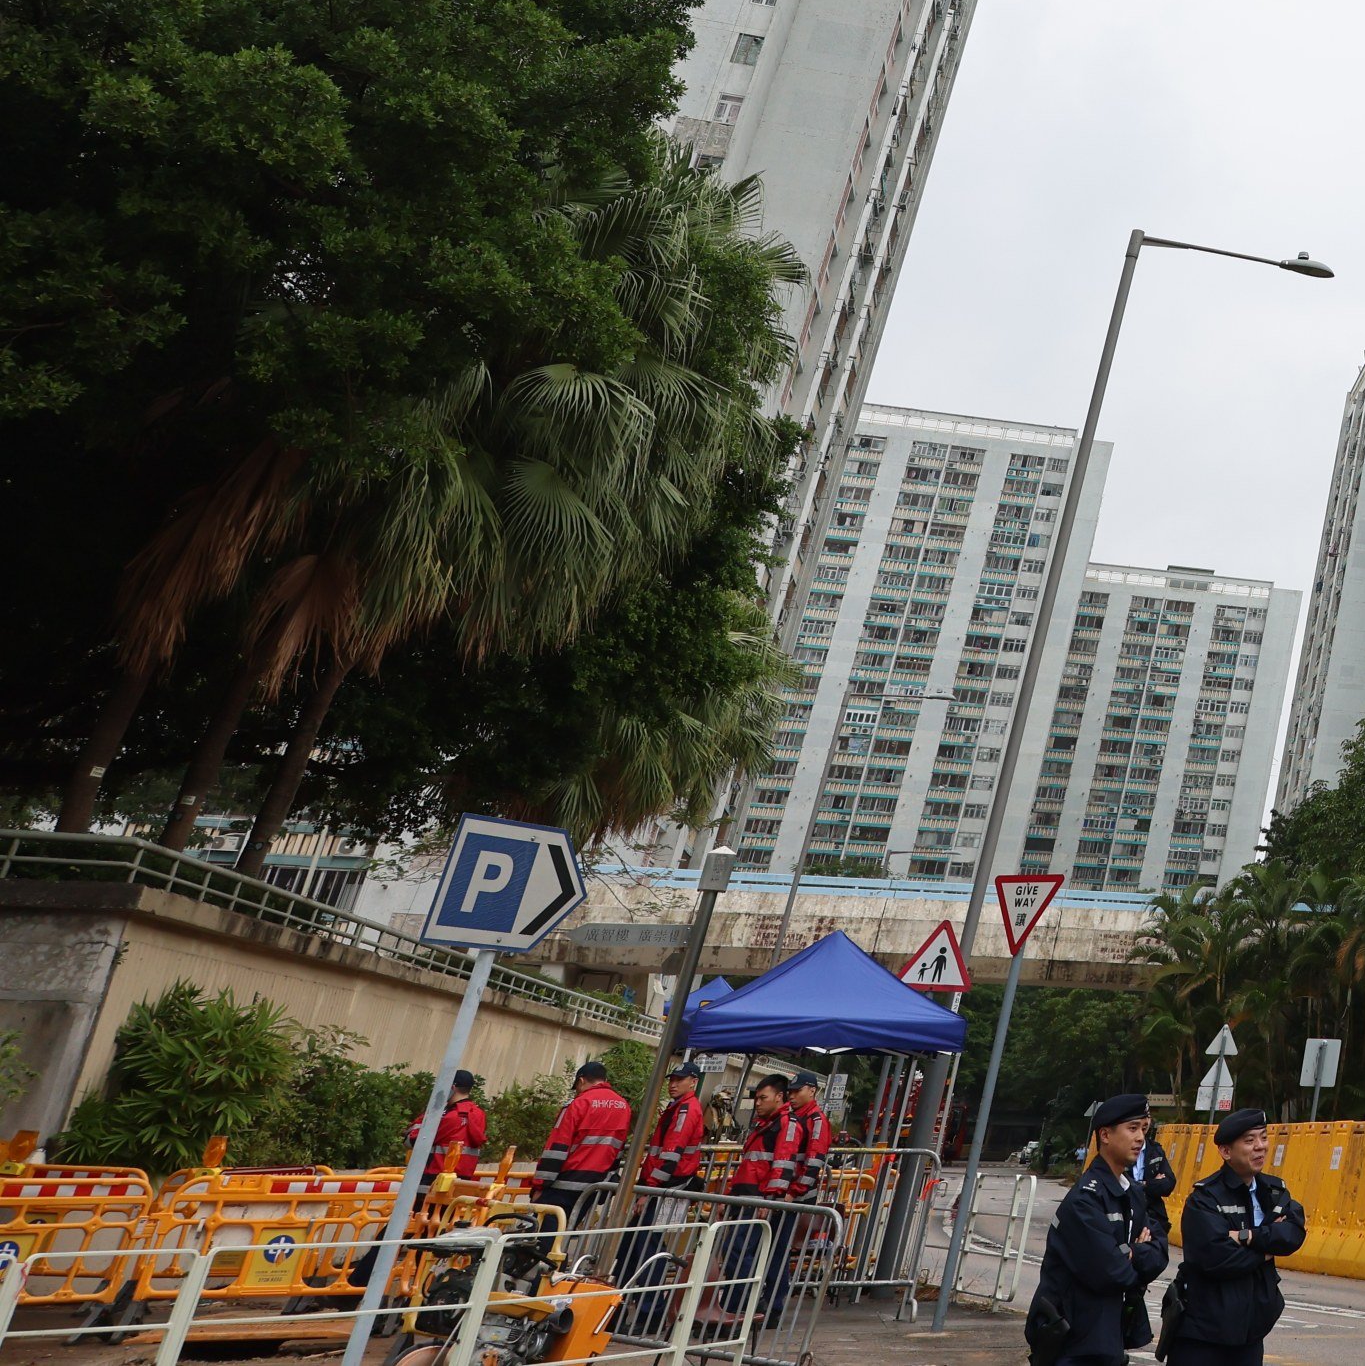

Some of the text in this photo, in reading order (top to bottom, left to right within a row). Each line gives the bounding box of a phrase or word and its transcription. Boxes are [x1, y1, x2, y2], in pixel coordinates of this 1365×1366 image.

[460, 850, 514, 913] P
[1016, 886, 1039, 895] GIVE
[1014, 898, 1036, 907] WAY
[1015, 913, 1027, 926] 讓
[585, 928, 629, 942] 廣智樓
